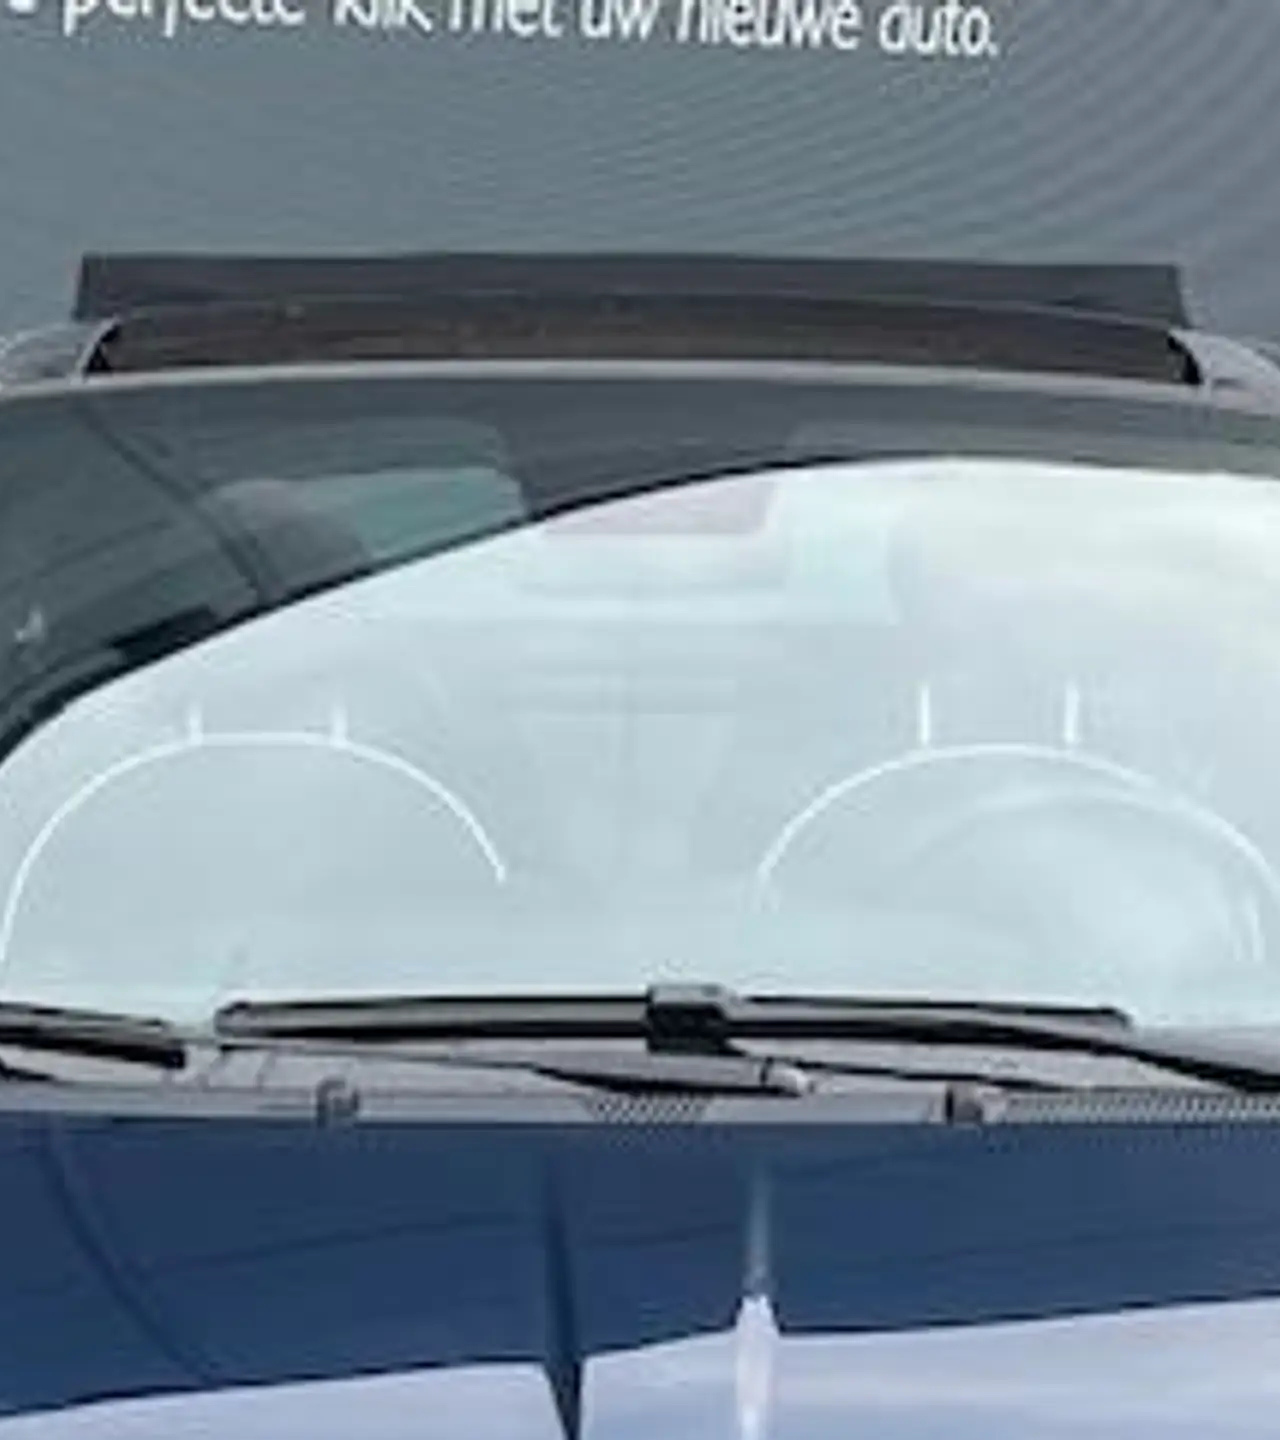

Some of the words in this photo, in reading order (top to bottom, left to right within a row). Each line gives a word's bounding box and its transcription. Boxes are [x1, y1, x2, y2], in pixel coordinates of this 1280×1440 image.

[580, 0, 661, 41] uw
[676, 0, 862, 50] nieuwe
[879, 0, 999, 57] auto.
